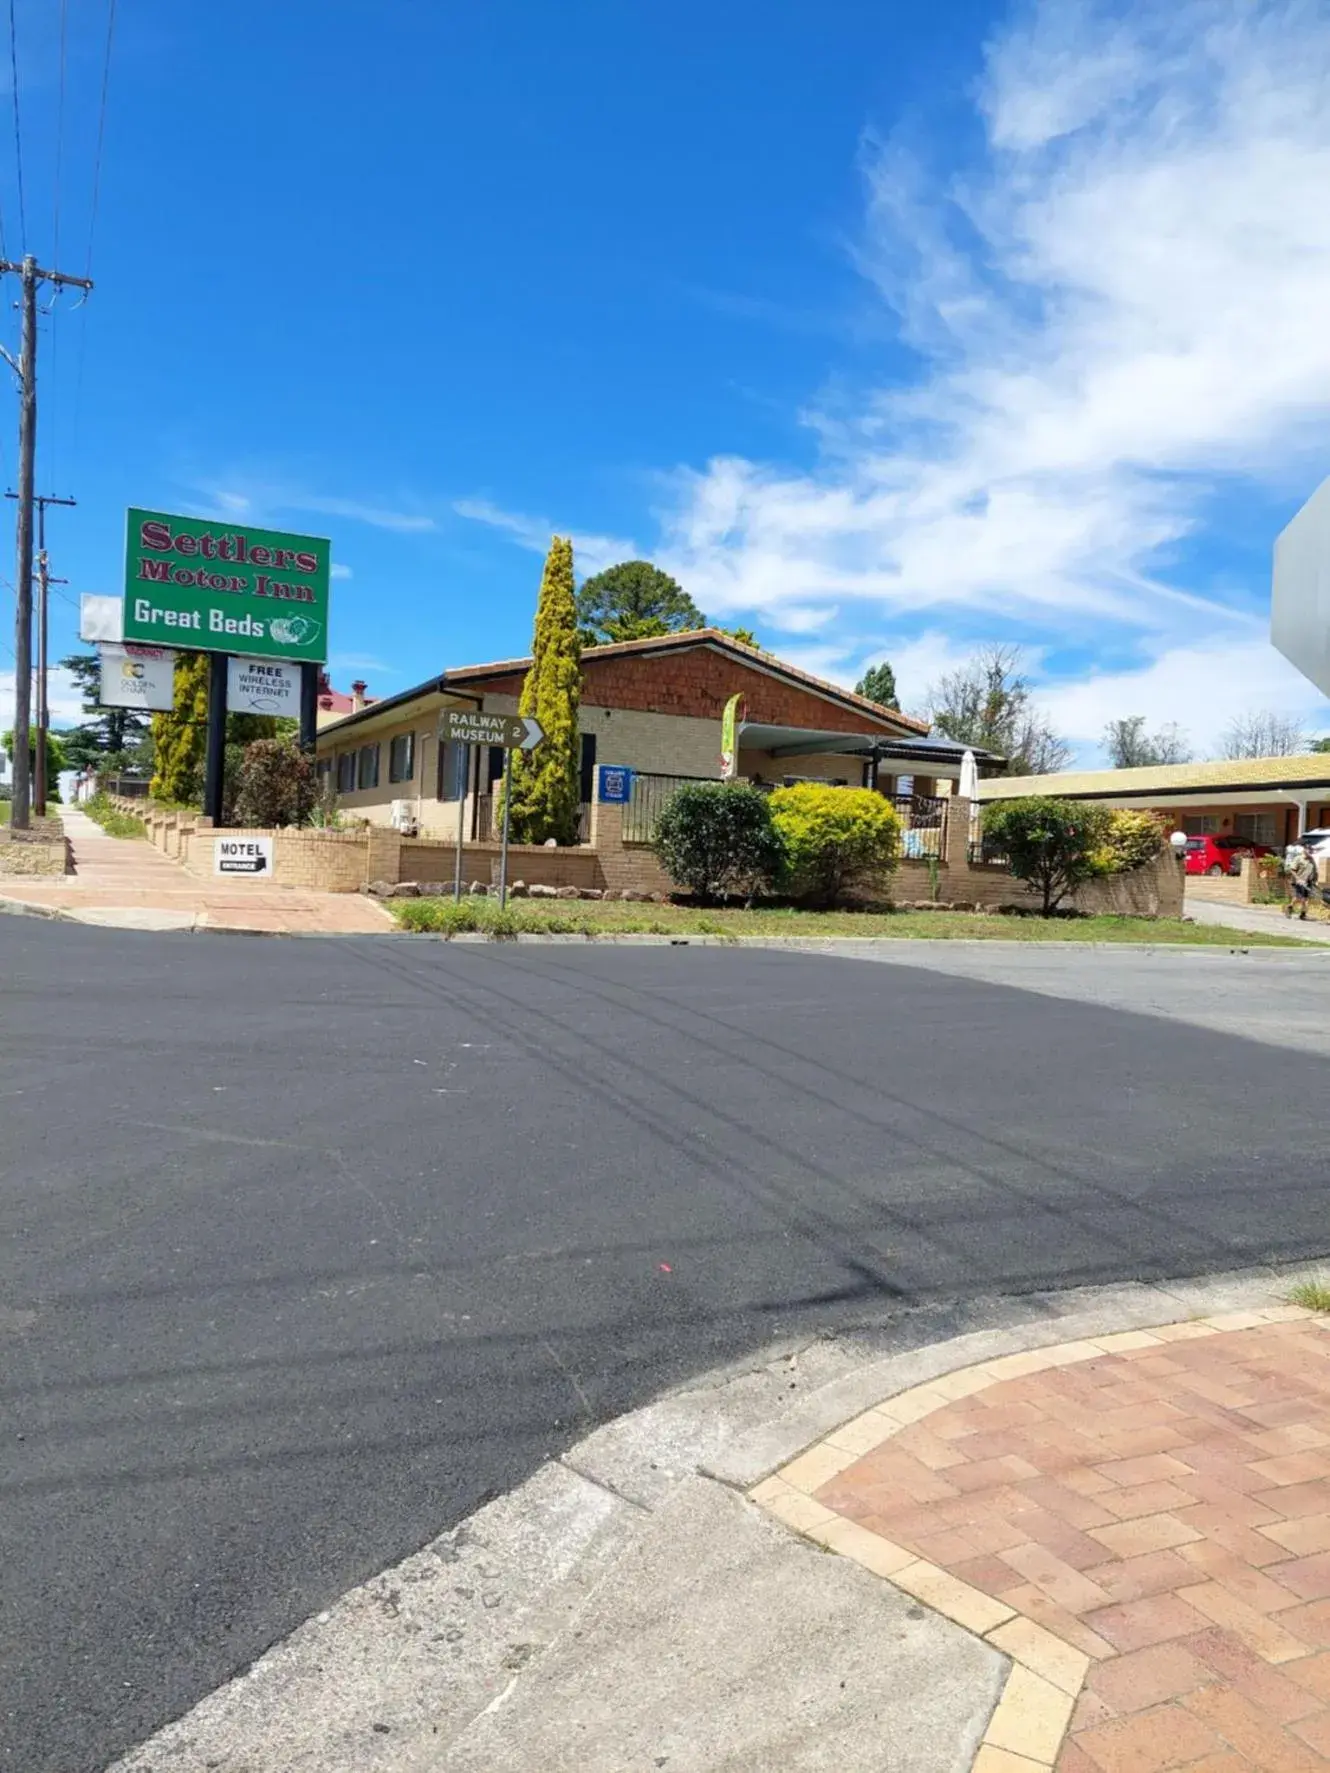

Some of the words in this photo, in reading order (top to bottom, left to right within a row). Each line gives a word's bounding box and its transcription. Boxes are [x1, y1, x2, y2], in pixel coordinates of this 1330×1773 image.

[140, 519, 318, 575] Settlers
[136, 556, 248, 595] Motor
[252, 572, 317, 603] Inn
[134, 598, 202, 630] Great
[208, 607, 265, 638] Beds
[248, 663, 283, 678] FREE
[238, 673, 292, 689] WIRELESS
[239, 684, 289, 698] INTERNET
[449, 712, 507, 730] RAILWAY
[450, 727, 505, 744] MUSEUM
[512, 726, 521, 738] 2
[221, 843, 264, 856] MOTEL
